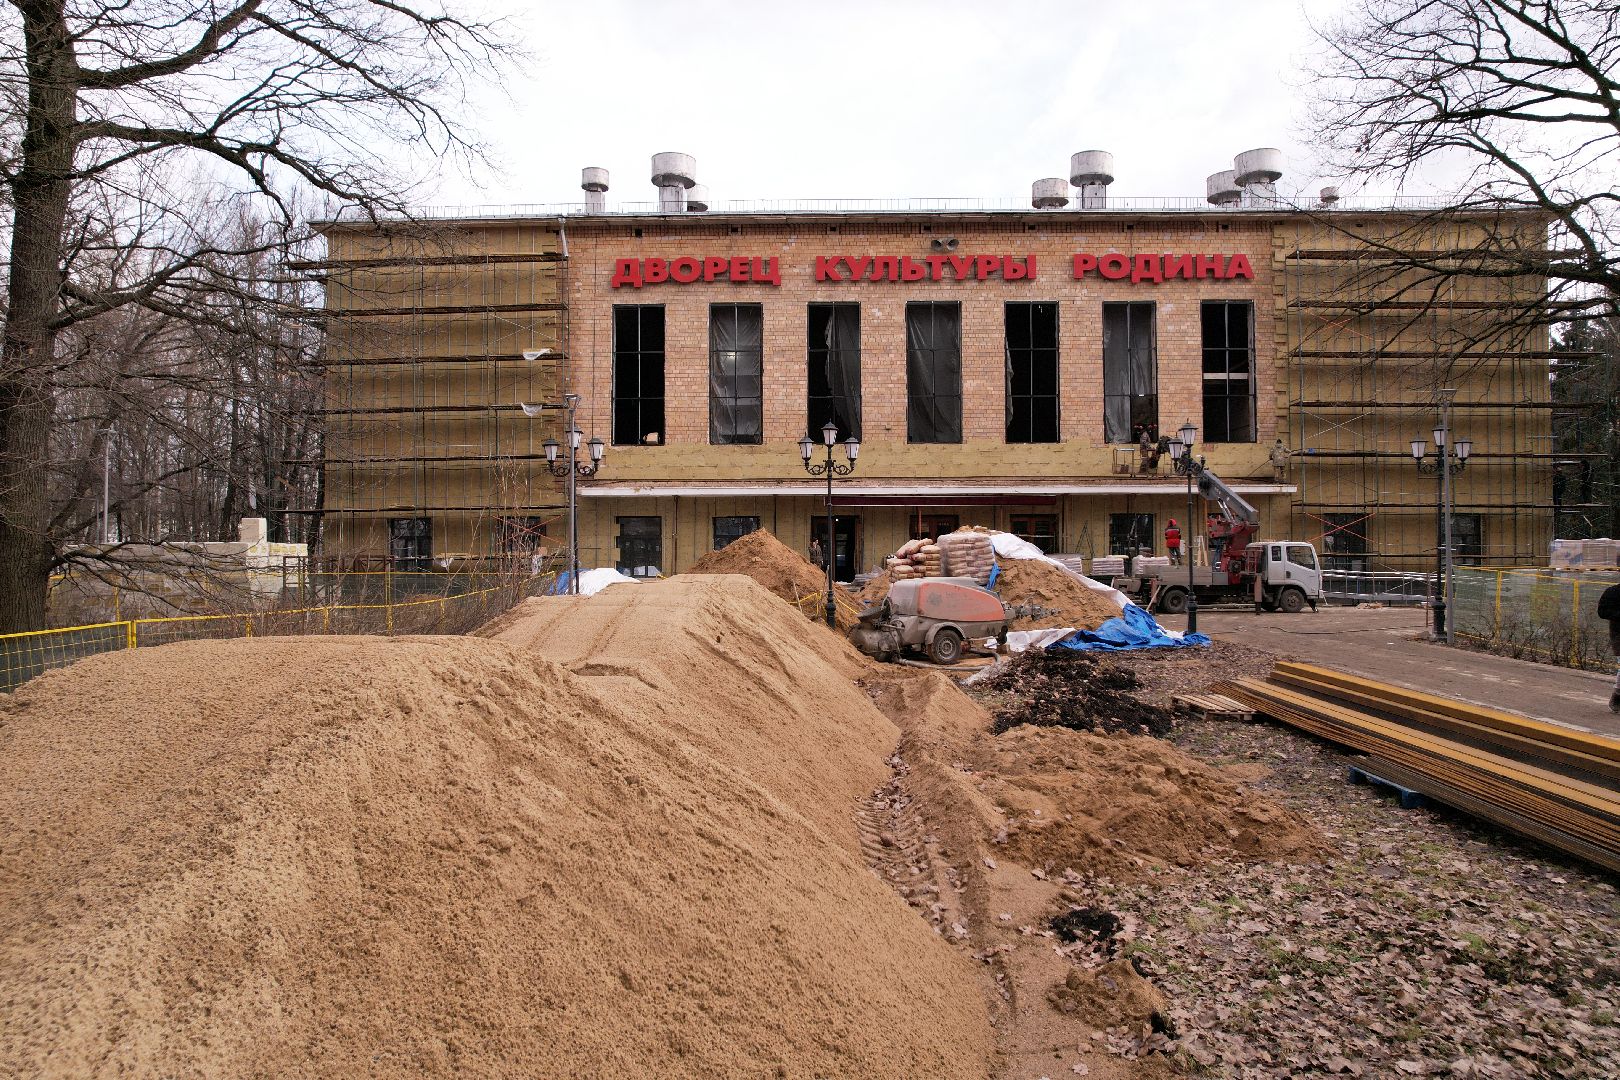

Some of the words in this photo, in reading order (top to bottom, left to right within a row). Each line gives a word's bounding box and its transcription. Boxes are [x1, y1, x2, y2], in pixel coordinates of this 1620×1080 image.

[611, 256, 782, 288] ДВОРЕЦ
[815, 254, 1037, 282] КУЛЬТУРЫ
[1073, 253, 1255, 284] РОДИНА
